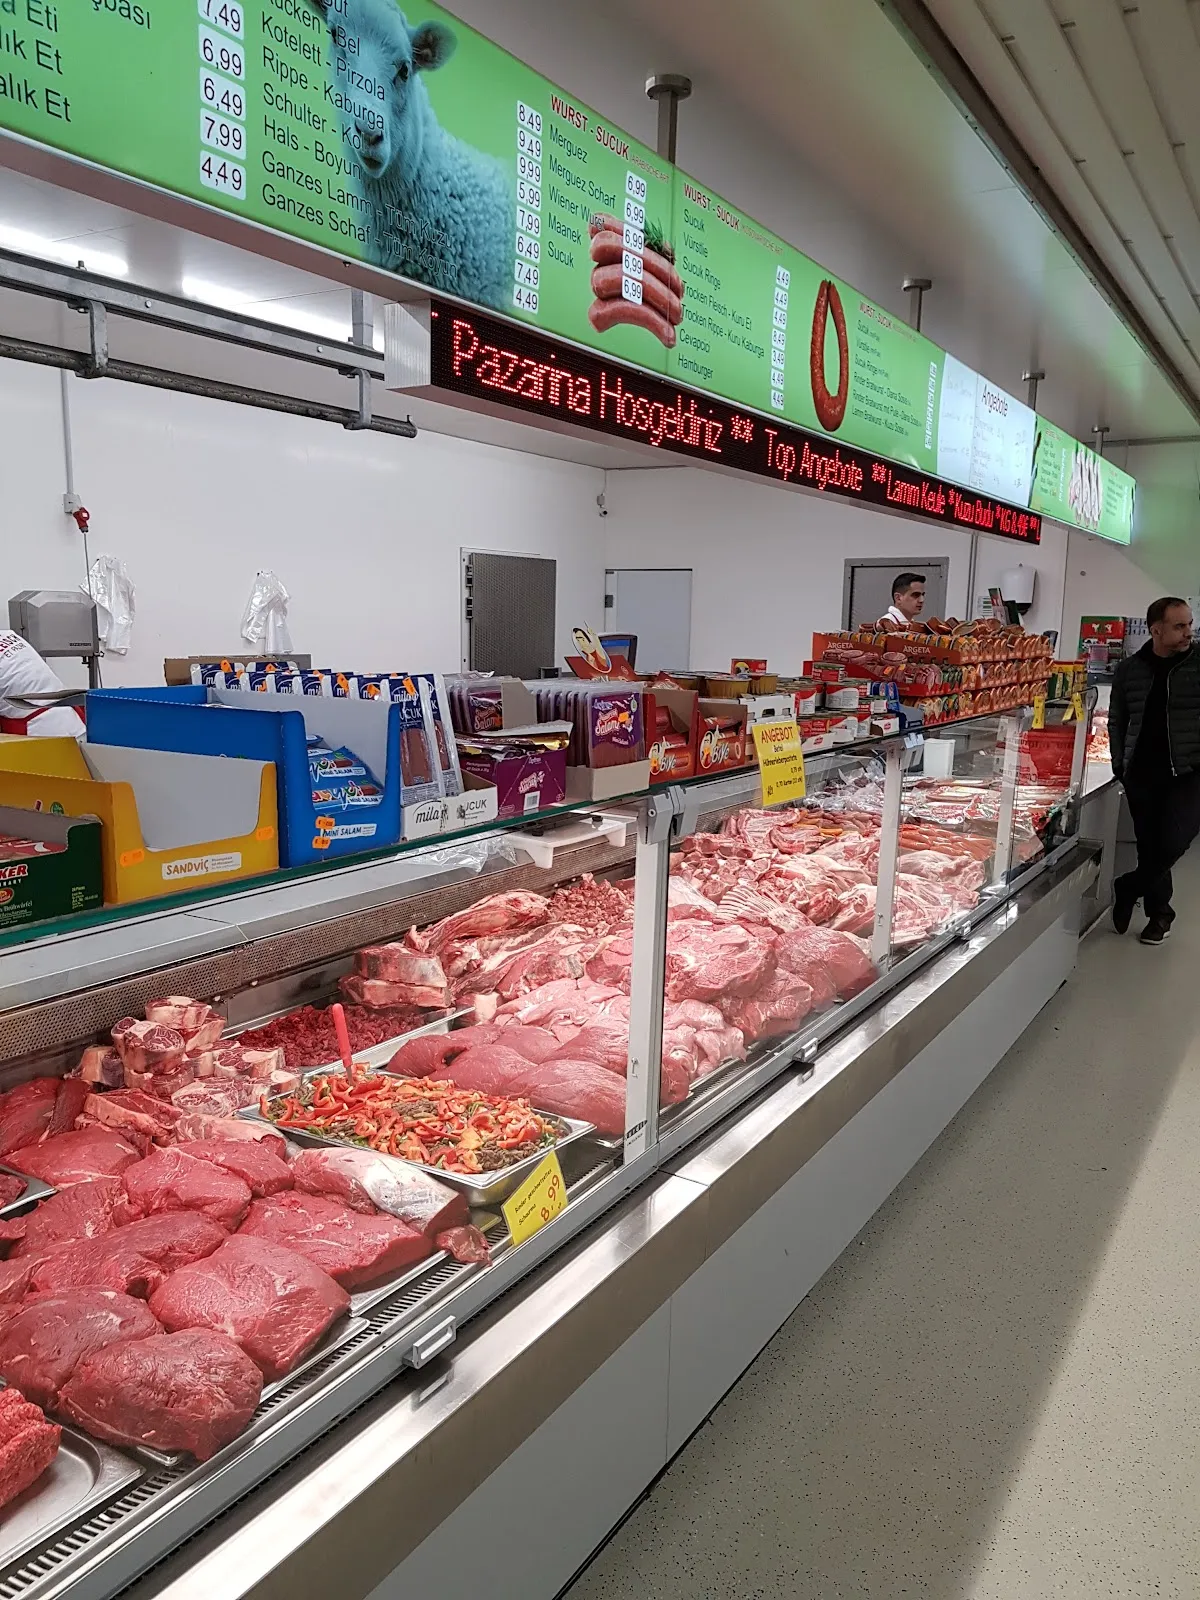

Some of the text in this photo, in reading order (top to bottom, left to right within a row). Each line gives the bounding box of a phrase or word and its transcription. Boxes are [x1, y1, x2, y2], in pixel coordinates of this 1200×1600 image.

[27, 0, 58, 32] Eti
[271, 0, 321, 34] cken
[337, 25, 360, 57] Bel
[36, 40, 63, 75] Et
[203, 38, 242, 76] 6,99
[262, 11, 322, 67] Kotelett
[336, 58, 386, 101] Pirzola
[45, 88, 71, 122] Et
[203, 78, 243, 117] 6,49
[263, 46, 308, 91] Rippe
[323, 82, 385, 131] Kaburga
[263, 83, 327, 133] Schulter
[204, 116, 242, 150] 7,99
[551, 93, 588, 133] WURST
[595, 127, 630, 160] SUCUK
[264, 115, 299, 151] Hals
[315, 140, 361, 180] Boyun
[550, 125, 588, 164] Merguez
[202, 156, 242, 191] 4,49
[519, 157, 541, 183] 9,99
[549, 155, 617, 210] Merguez Scharf
[262, 151, 323, 195] Ganzes
[327, 179, 373, 217] Lamm
[384, 203, 417, 235] Tüm
[420, 219, 453, 248] Kuzu
[519, 183, 541, 209] 5,99
[627, 181, 646, 199] 6,99
[684, 182, 740, 231] WURST SUCUK
[519, 210, 540, 235] 7,99
[549, 185, 605, 231] Wiener Wurst
[626, 205, 644, 224] 6,99
[683, 208, 705, 232] Sucuk
[262, 184, 324, 226] Ganzes
[328, 211, 371, 244] Schaf
[383, 230, 413, 261] Tüm
[419, 247, 458, 280] Koyun
[548, 213, 582, 245] Maanek
[625, 230, 643, 249] 6,99
[517, 236, 540, 260] 6,49
[548, 242, 575, 268] Sucuk
[516, 263, 539, 287] 7,49
[624, 257, 642, 275] 6,99
[682, 256, 721, 291] Sucuk Ringe
[515, 289, 538, 313] 4,49
[624, 281, 642, 299] 6,99
[682, 280, 752, 331] Trocken Fleisch Kuru Et
[681, 303, 765, 359] Trocken Rippe Kuru Kaburga
[678, 352, 713, 380] Hamburger
[453, 319, 591, 415] Pazarina
[765, 428, 796, 481] Top
[800, 441, 863, 491] Angebote
[981, 383, 1009, 417] Angebote
[827, 641, 854, 651] ARGETA
[903, 645, 931, 655] ARGETA
[761, 726, 793, 744] ANGEBOT
[340, 826, 362, 837] SALAM
[166, 858, 209, 876] SANDVİÇ
[541, 1174, 560, 1222] 8,99
